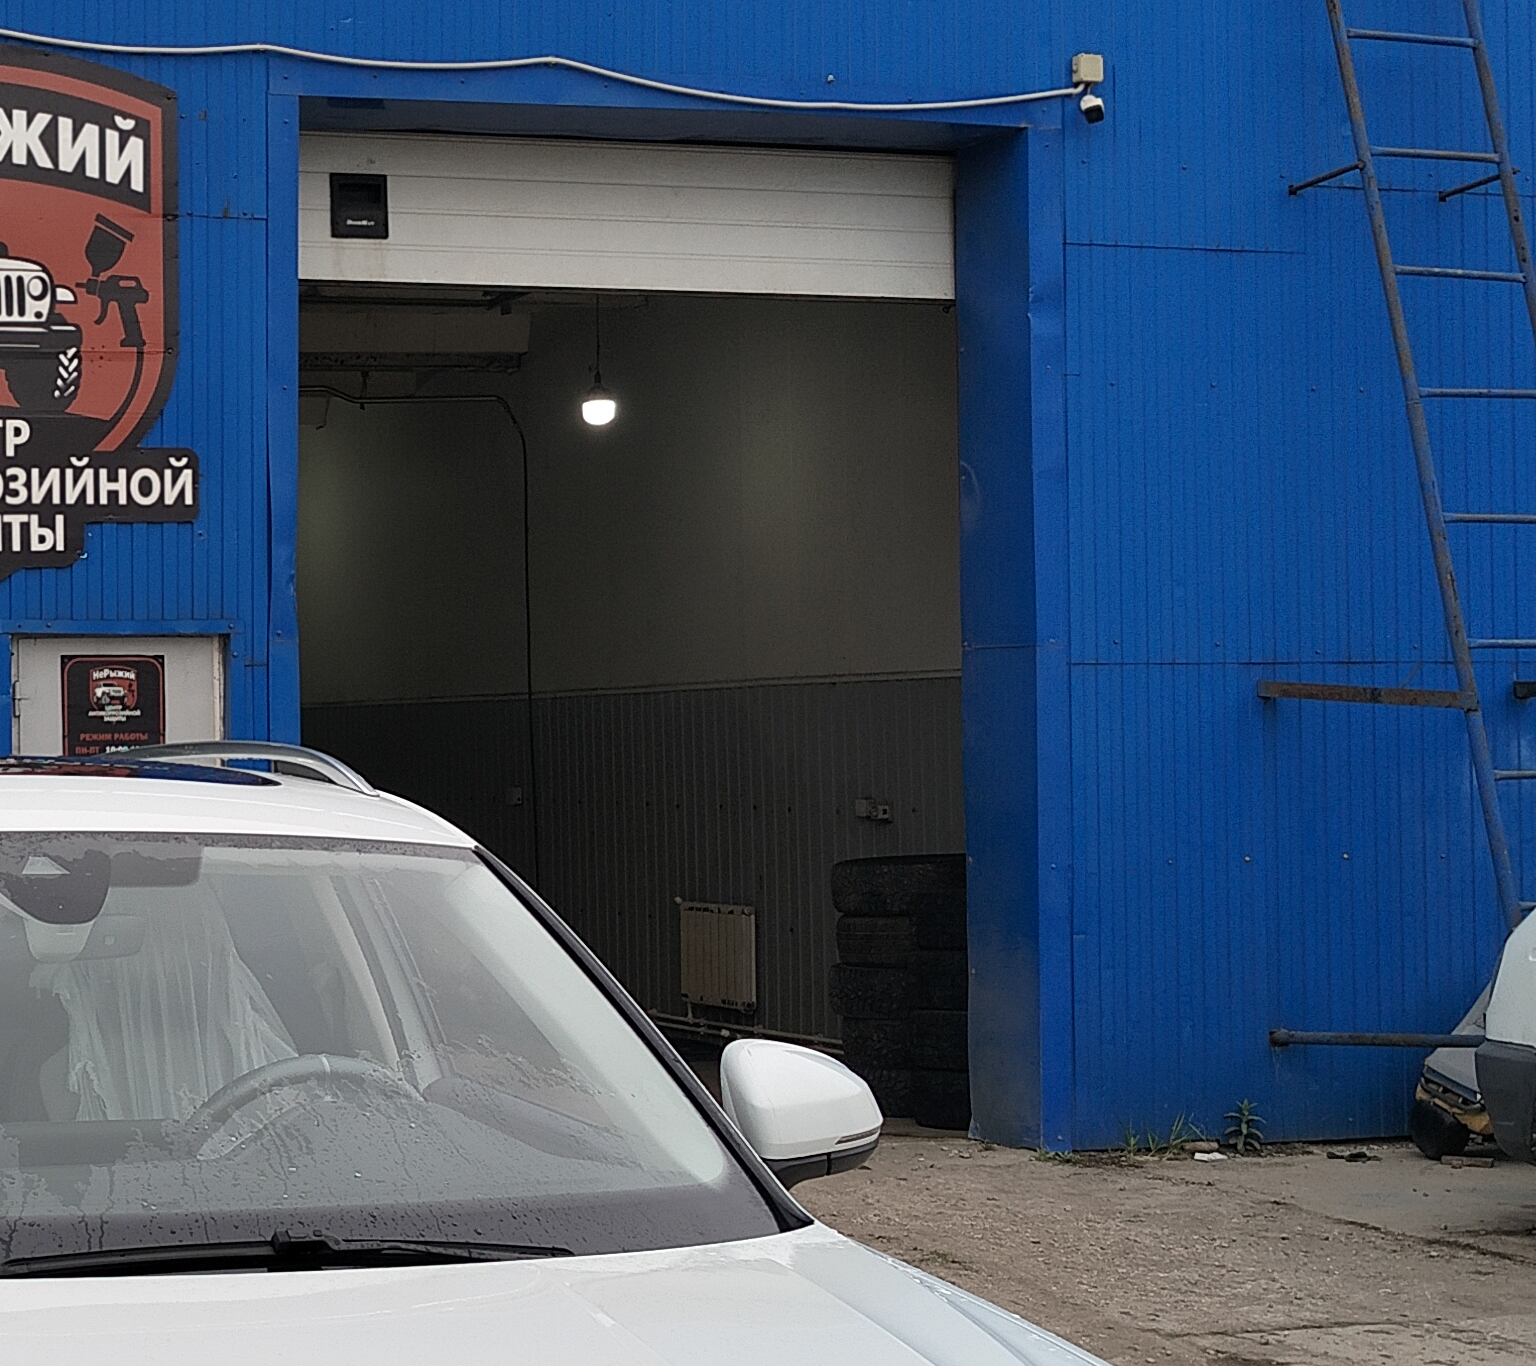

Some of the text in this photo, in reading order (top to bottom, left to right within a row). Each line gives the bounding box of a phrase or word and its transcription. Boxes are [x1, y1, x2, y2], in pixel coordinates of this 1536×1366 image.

[79, 732, 149, 741] РЕЖИМ РАБОТЫ
[75, 745, 100, 754] ПН-ПТ
